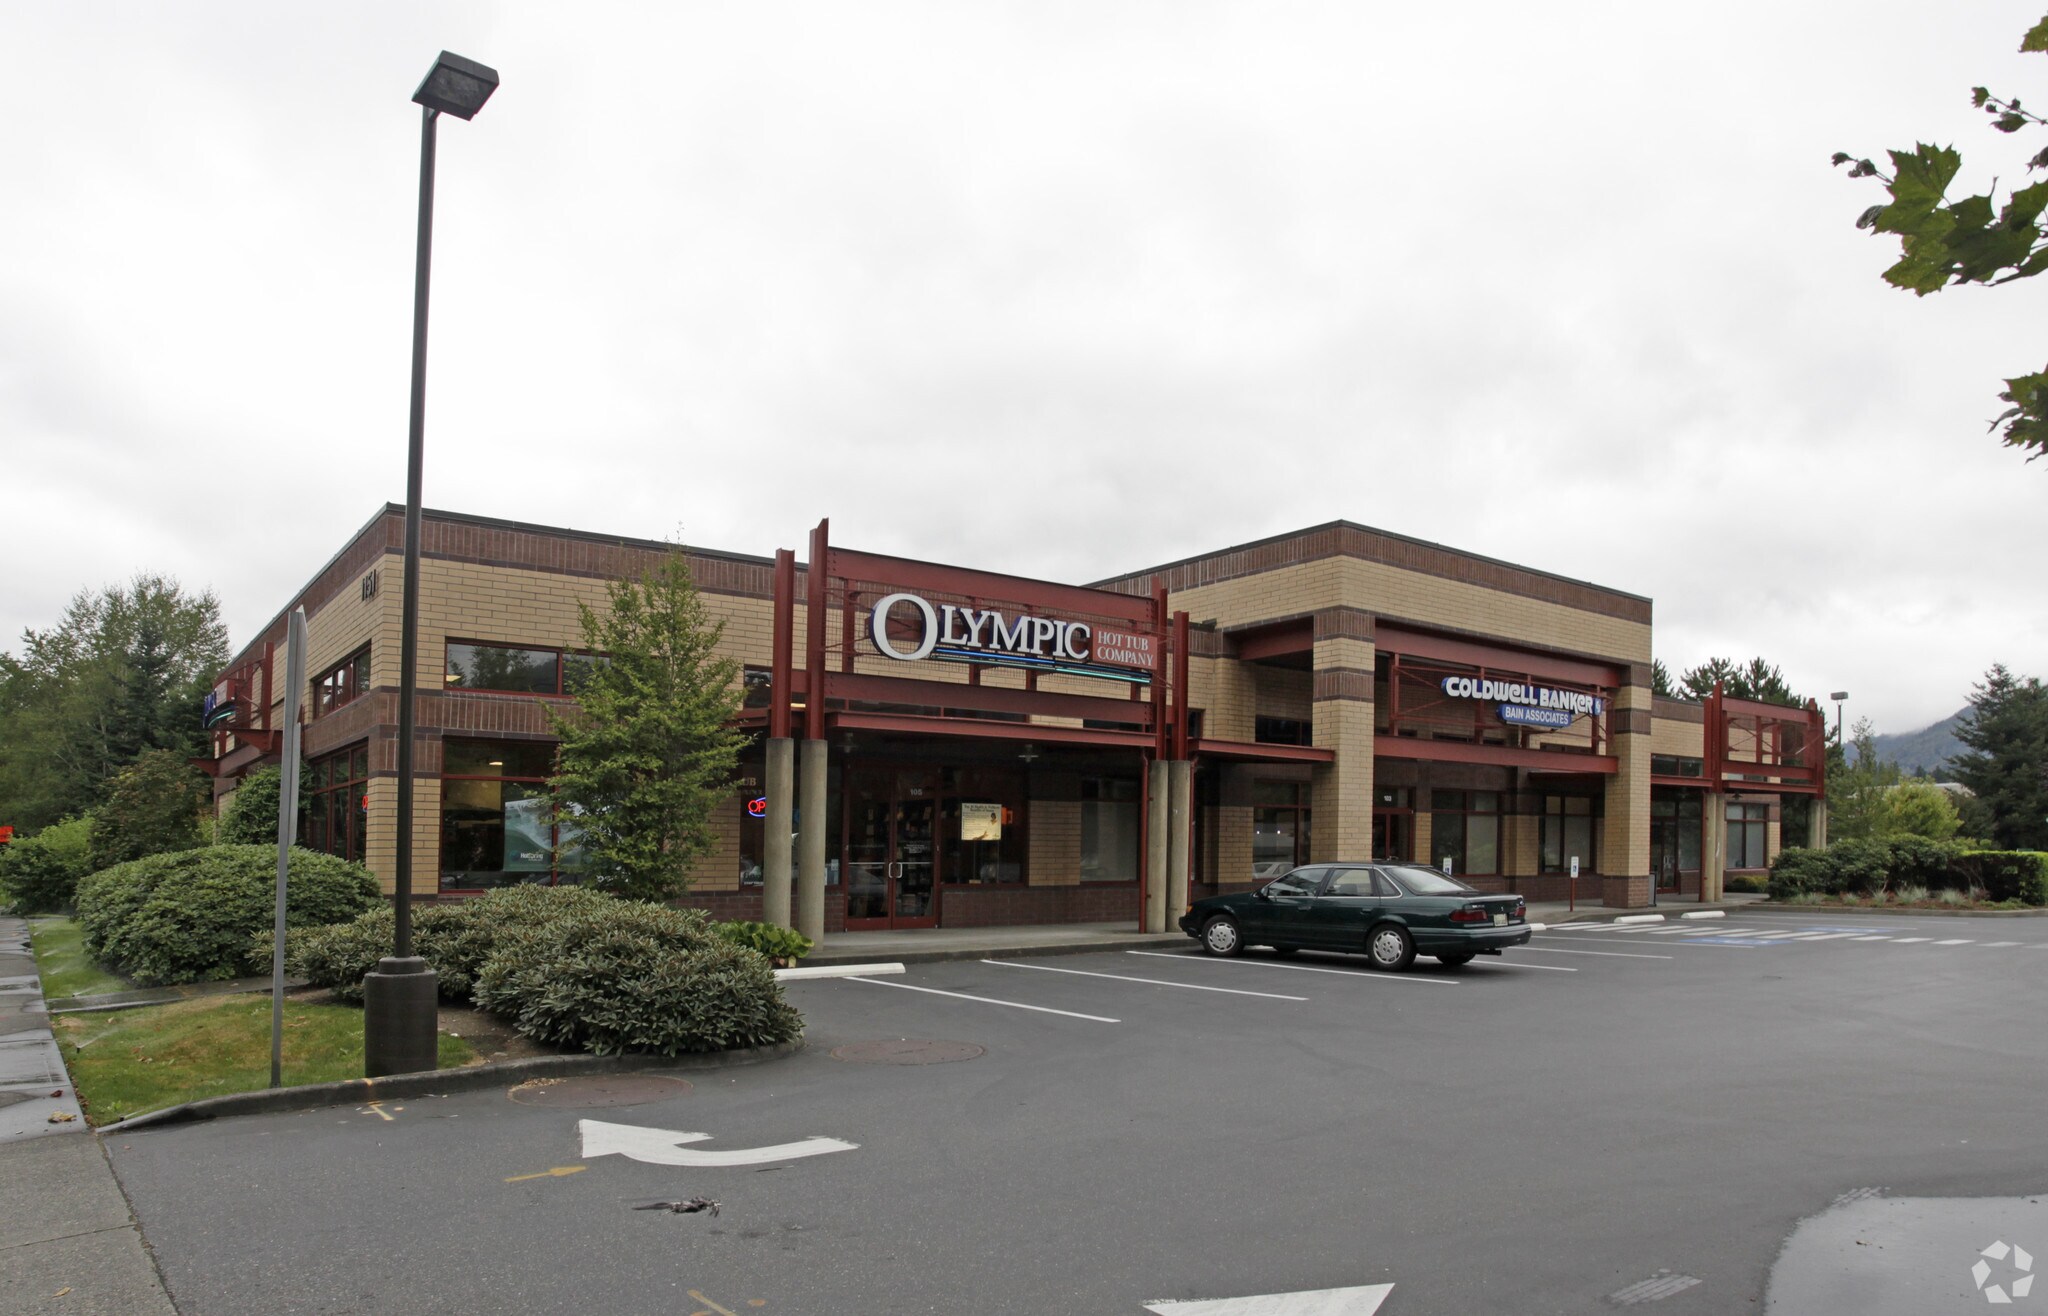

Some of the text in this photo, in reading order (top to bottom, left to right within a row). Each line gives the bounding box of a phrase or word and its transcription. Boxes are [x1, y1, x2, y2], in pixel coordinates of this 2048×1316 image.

[871, 593, 1090, 661] OLYMPIC
[1098, 631, 1148, 651] HOT TUB
[1097, 646, 1154, 667] COMPANY
[1505, 706, 1569, 725] BAIN ASSOCIATES
[748, 800, 766, 812] OP
